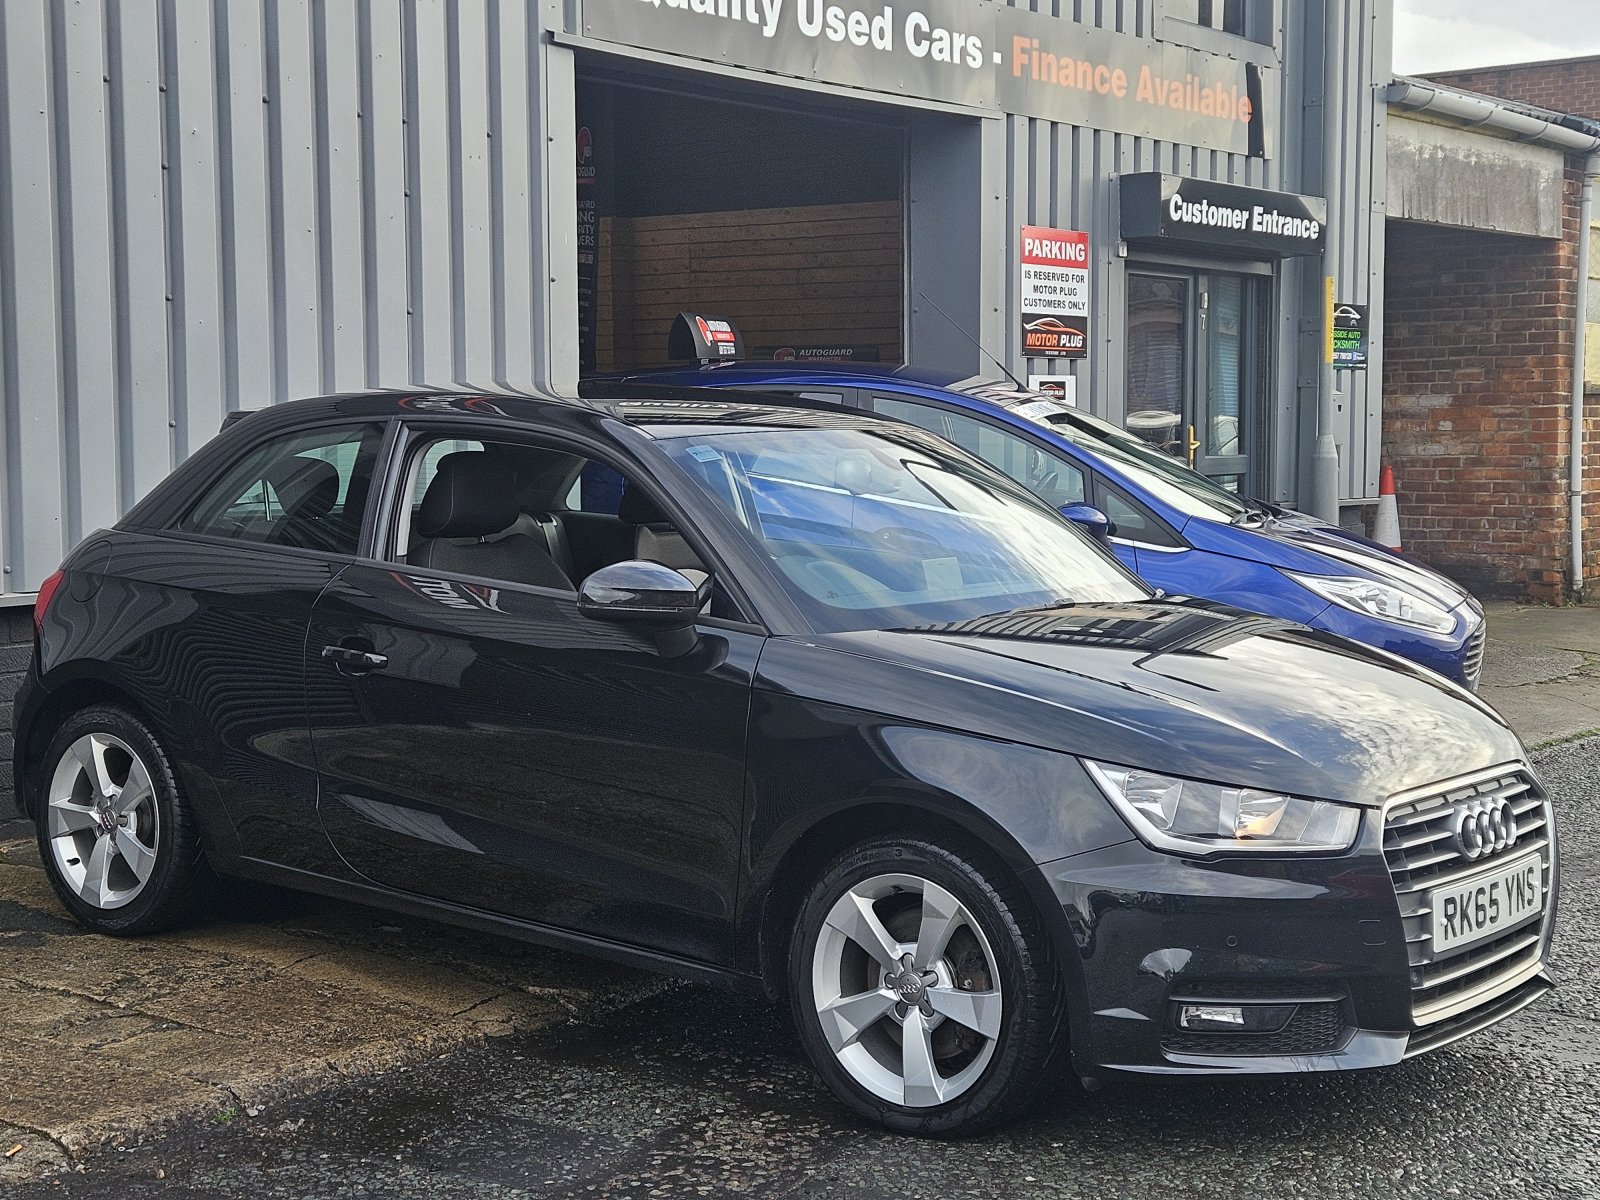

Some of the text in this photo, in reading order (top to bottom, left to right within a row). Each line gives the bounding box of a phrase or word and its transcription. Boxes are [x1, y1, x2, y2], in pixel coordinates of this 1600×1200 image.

[640, 0, 783, 38] ality
[797, 0, 893, 52] Used
[904, 11, 983, 69] Cars
[1012, 34, 1253, 123] Finance Available
[1169, 193, 1320, 240] Customer Entrance
[1024, 237, 1086, 262] PARKING
[1024, 269, 1085, 284] IS RESERVED FOR
[1032, 284, 1078, 297] MOTOR PLUG
[1023, 297, 1086, 311] CUSTOMERS ONLY
[1026, 332, 1084, 348] MOTOR PLUG
[1347, 331, 1361, 339] AUTO
[1333, 339, 1361, 350] CKSMITH
[799, 348, 853, 357] AUTOGUARD
[894, 848, 904, 858] 3
[1443, 865, 1536, 941] RK65 YNS
